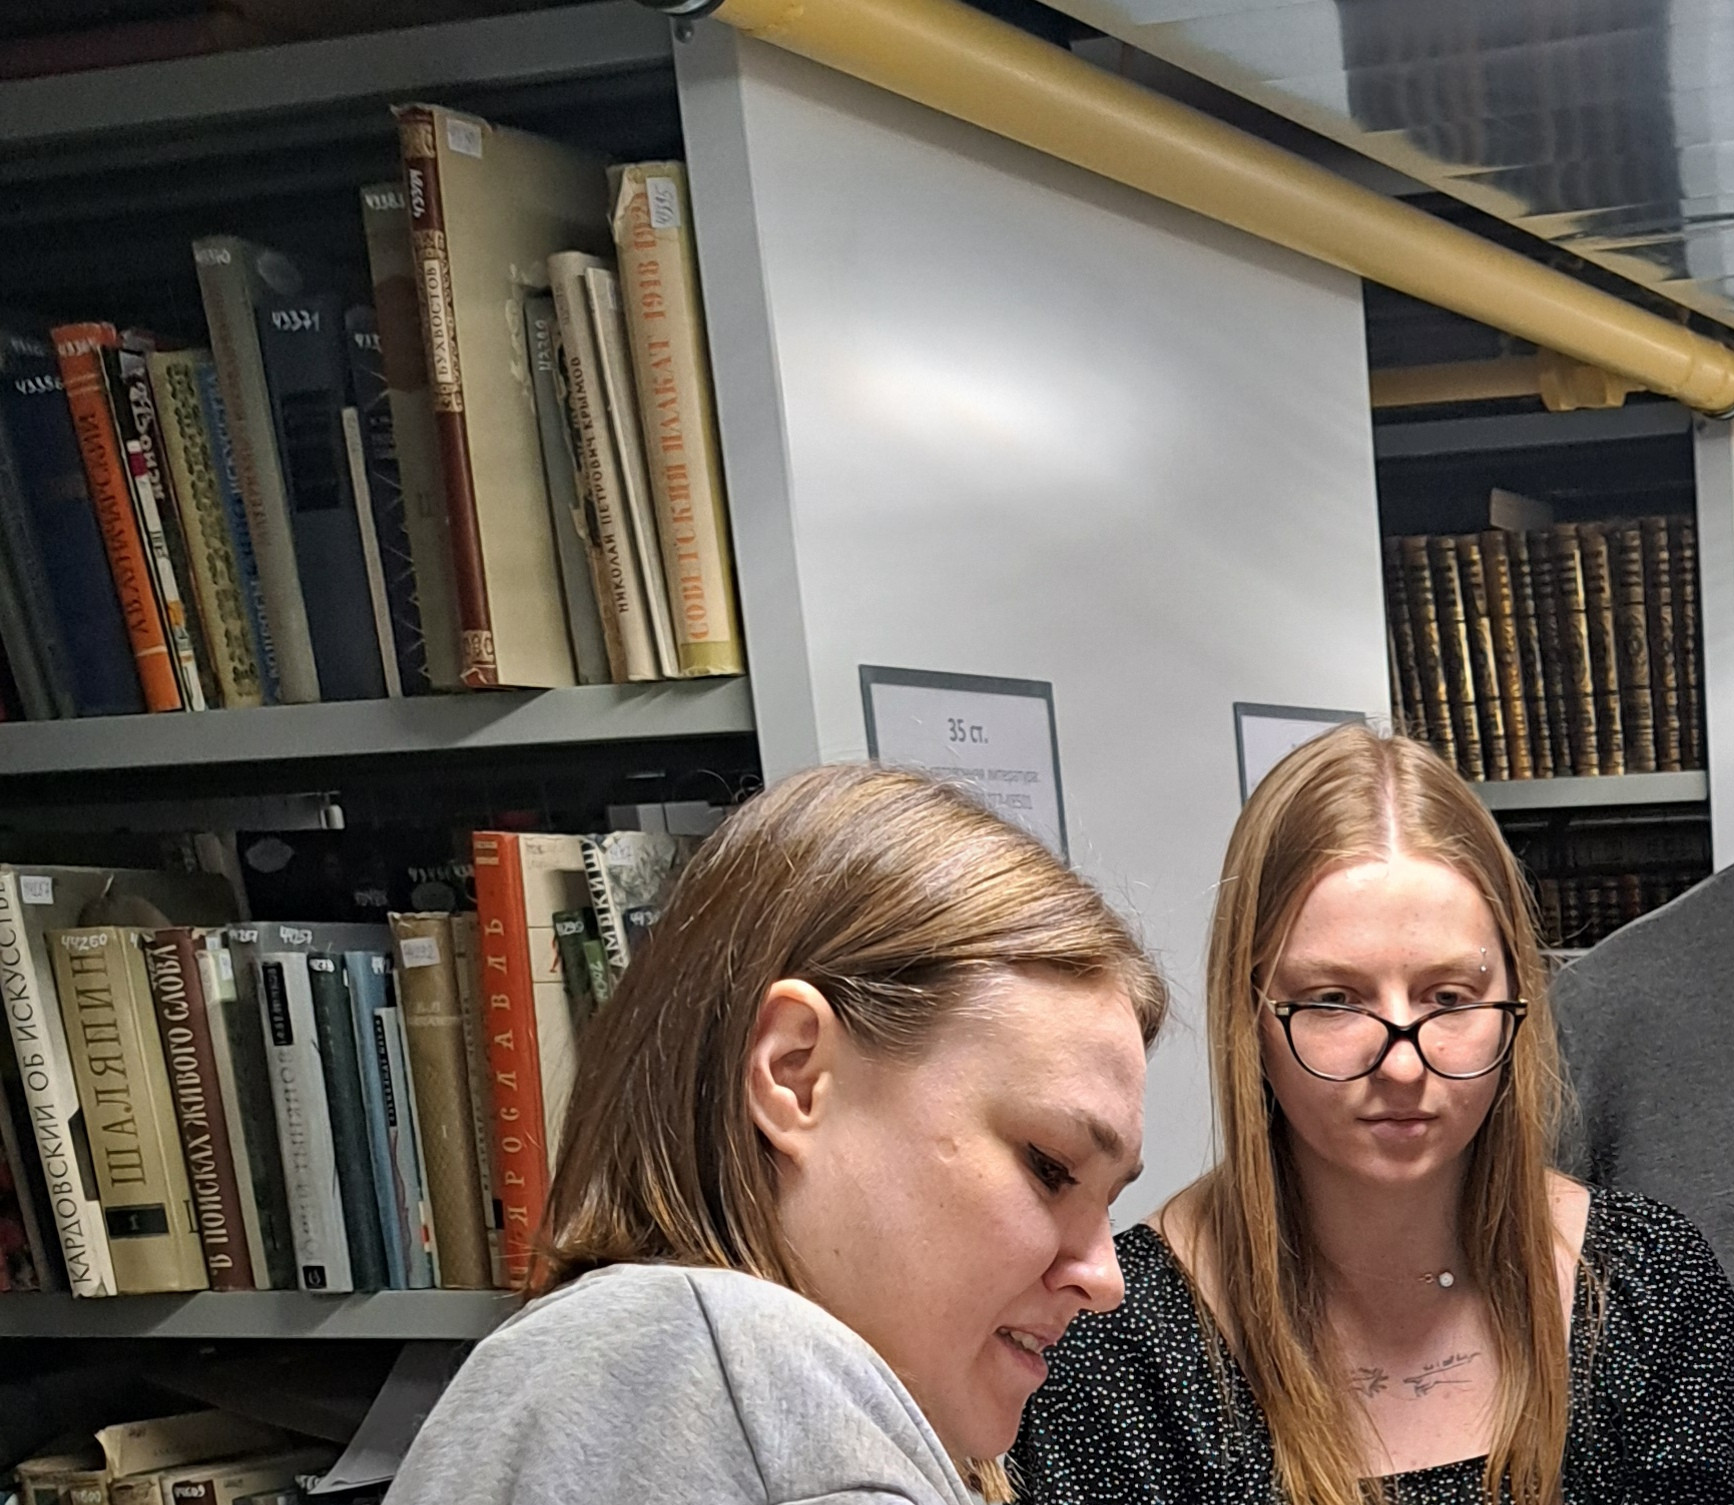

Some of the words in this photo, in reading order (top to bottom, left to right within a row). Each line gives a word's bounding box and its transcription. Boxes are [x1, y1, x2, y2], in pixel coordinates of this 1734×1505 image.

[426, 266, 449, 377] БУХВОСТОВ
[638, 259, 668, 321] 1918
[573, 356, 596, 431] КРЫМОВ
[654, 340, 687, 456] ПЛАКАТ
[587, 434, 613, 527] ПЕТРОВИЧ
[604, 532, 629, 613] НИКОЛАЙ
[667, 465, 707, 642] СОВЕТСКИЙ
[948, 718, 966, 742] 35
[970, 725, 988, 743] ст.
[0, 881, 39, 1042] ИСКУССТ
[153, 944, 190, 1021] СЛОВА
[25, 1054, 49, 1092] ОБ
[70, 952, 146, 1187] ШАЛЯПИН
[171, 1028, 211, 1129] ЖИВОГО
[485, 918, 528, 1226] ЯРОСЛАВЛЬ
[33, 1105, 91, 1285] КАРДОВСКИЙ
[189, 1132, 230, 1246] ПОИСКАХ
